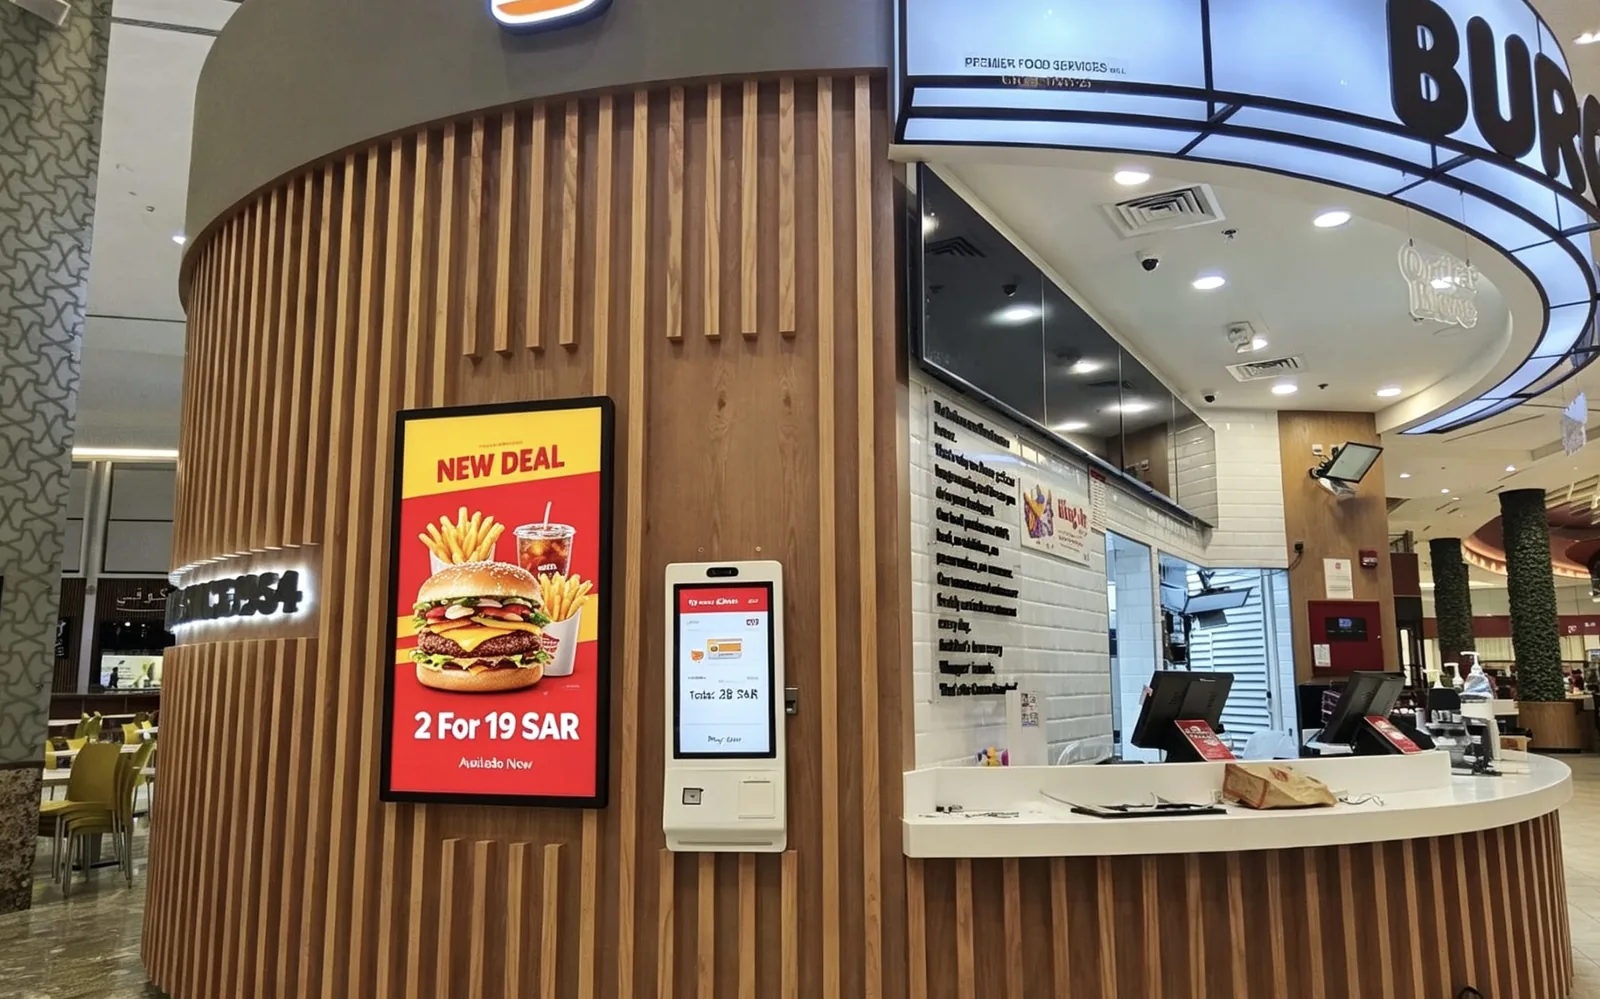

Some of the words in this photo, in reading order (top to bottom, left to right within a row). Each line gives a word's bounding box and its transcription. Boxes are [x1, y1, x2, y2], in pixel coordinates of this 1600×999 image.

[1018, 58, 1050, 70] FOOD
[1053, 60, 1108, 73] SERVICES
[437, 453, 495, 483] NEW
[501, 445, 565, 475] DEAL
[719, 688, 733, 700] 28
[413, 711, 432, 739] 2
[438, 712, 480, 739] For
[484, 711, 516, 739] 19
[521, 712, 579, 740] SAR
